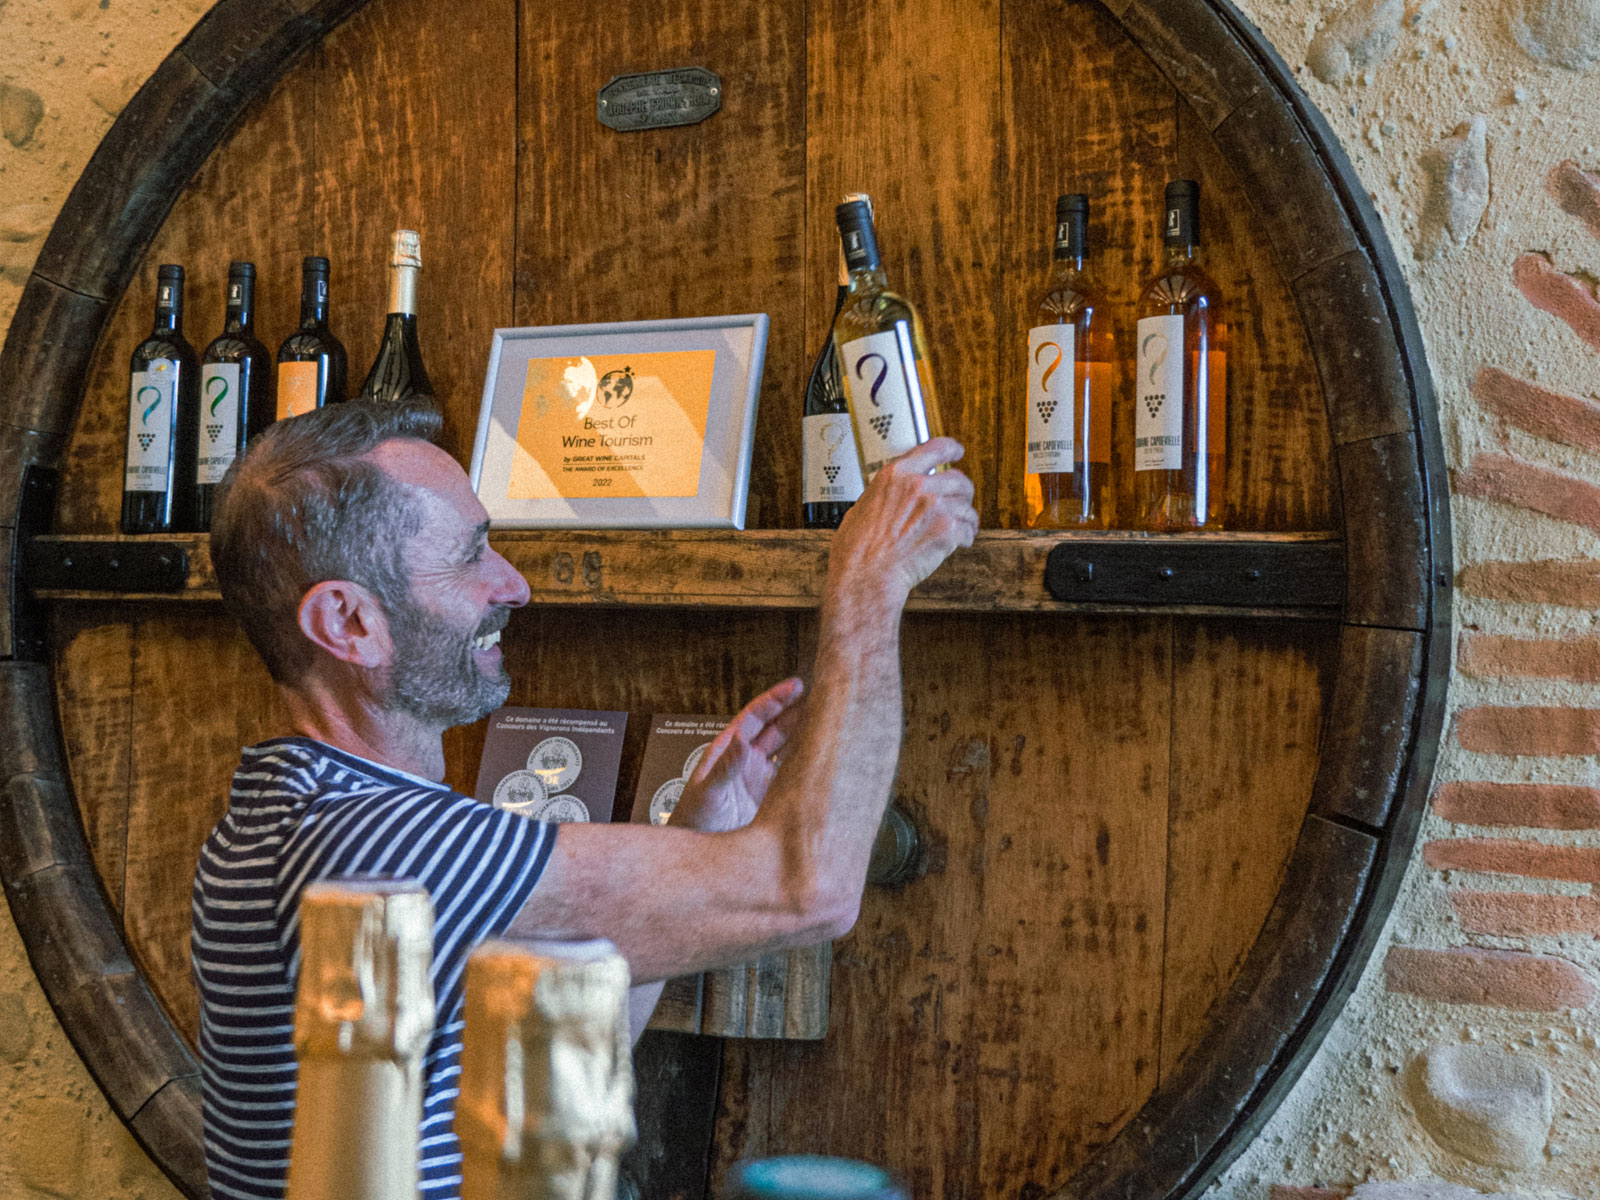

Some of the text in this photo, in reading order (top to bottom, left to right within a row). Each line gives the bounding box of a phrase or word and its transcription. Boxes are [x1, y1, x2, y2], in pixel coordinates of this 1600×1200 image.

[584, 415, 638, 430] Best Of
[562, 434, 653, 448] Wine Tourism
[592, 478, 613, 487] 2022
[505, 715, 514, 723] Ce
[515, 716, 541, 724] domaine
[547, 716, 559, 725] été
[559, 717, 598, 727] récompensé
[674, 720, 698, 728] domaine
[496, 722, 615, 735] Concours des Vignerons Indépendants
[656, 727, 683, 735] Concours
[696, 728, 722, 737] Vignero
